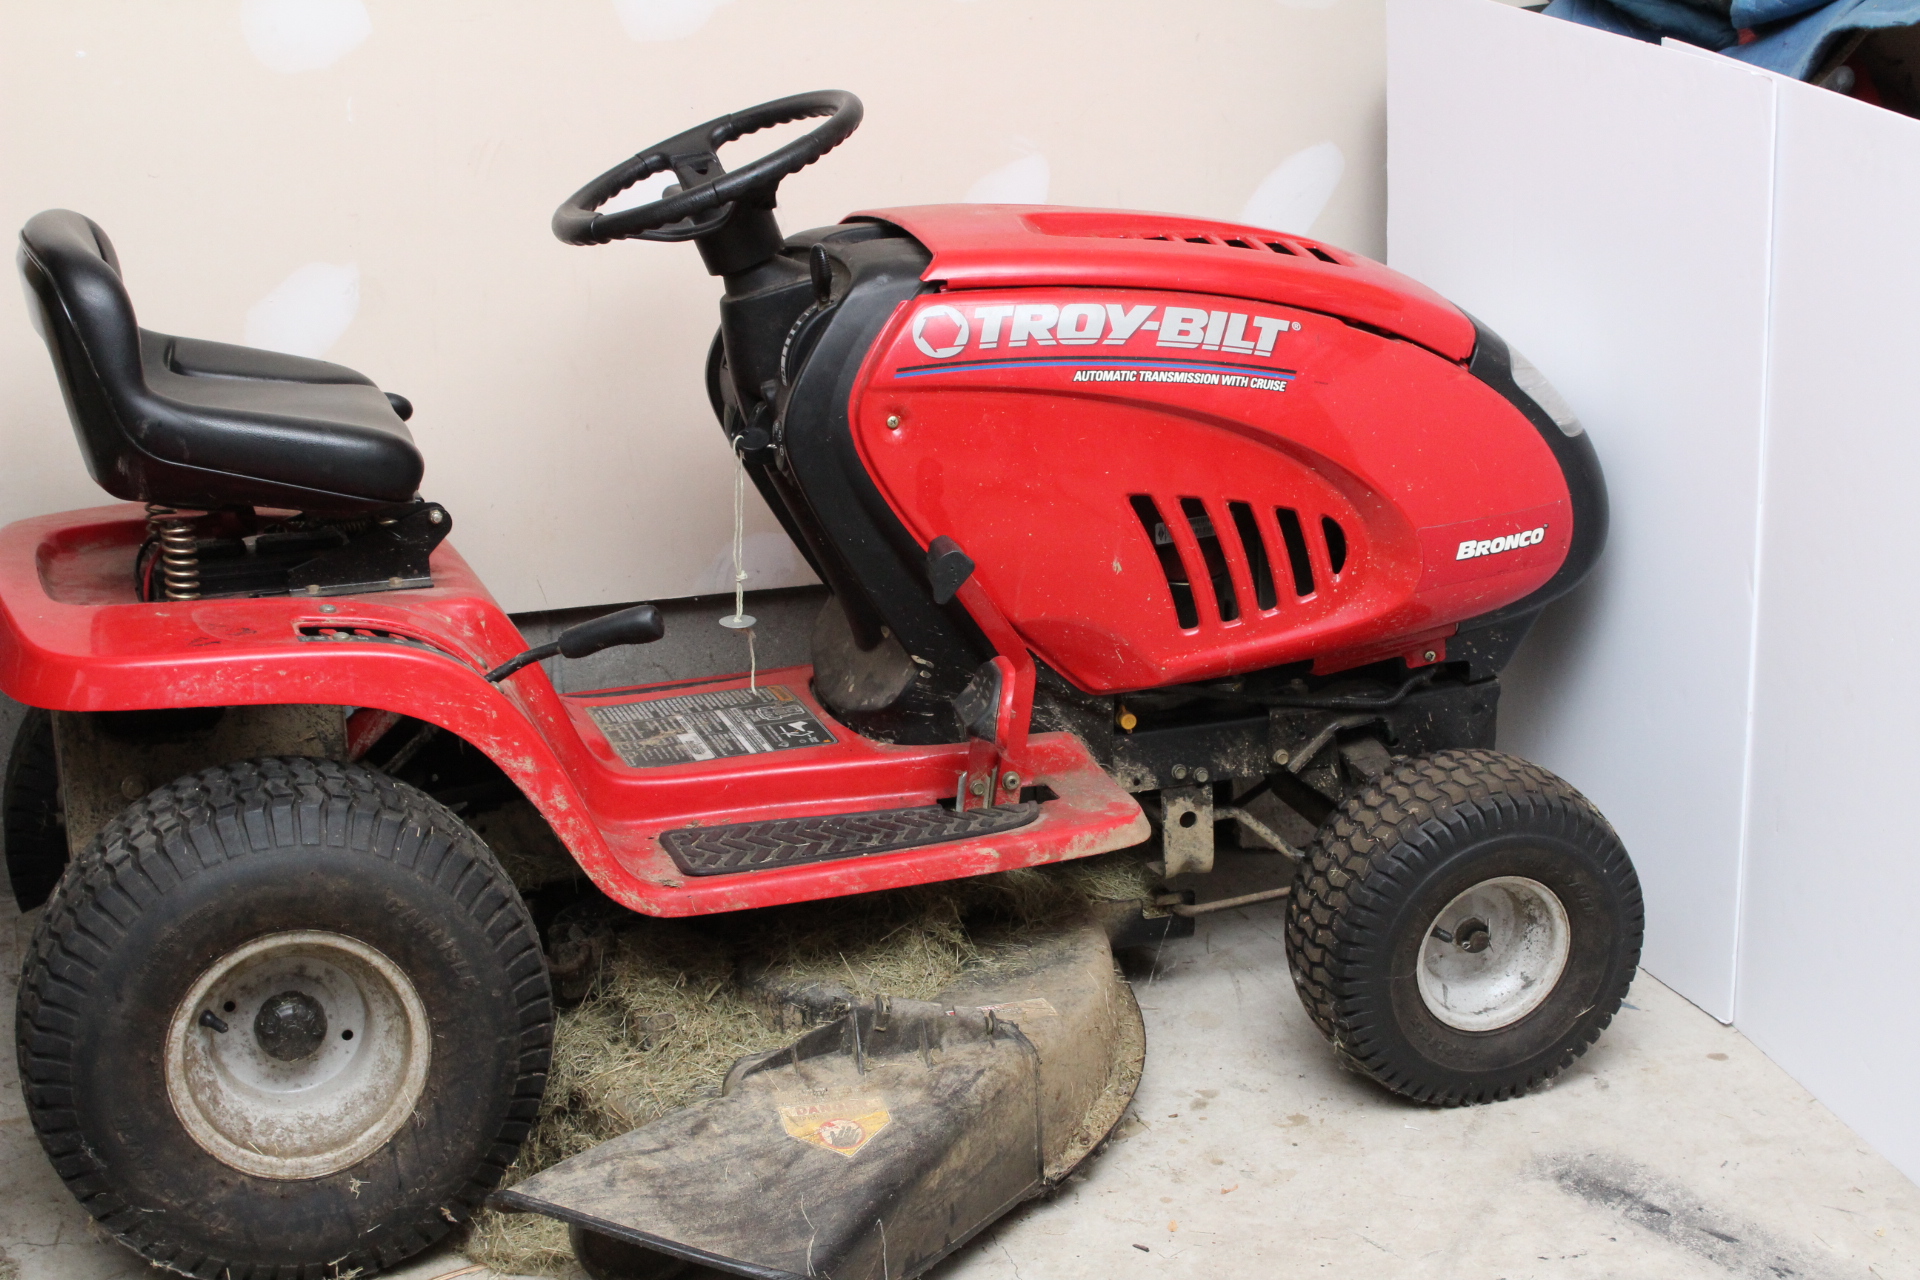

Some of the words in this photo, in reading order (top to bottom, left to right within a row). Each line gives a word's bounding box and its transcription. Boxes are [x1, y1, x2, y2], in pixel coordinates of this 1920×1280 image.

[1073, 370, 1137, 382] AUTOMATIC
[1138, 370, 1219, 385] TRANSMISSION
[1221, 374, 1249, 388] WITH
[1249, 377, 1288, 393] CRUISE
[1455, 527, 1545, 561] BRONCO
